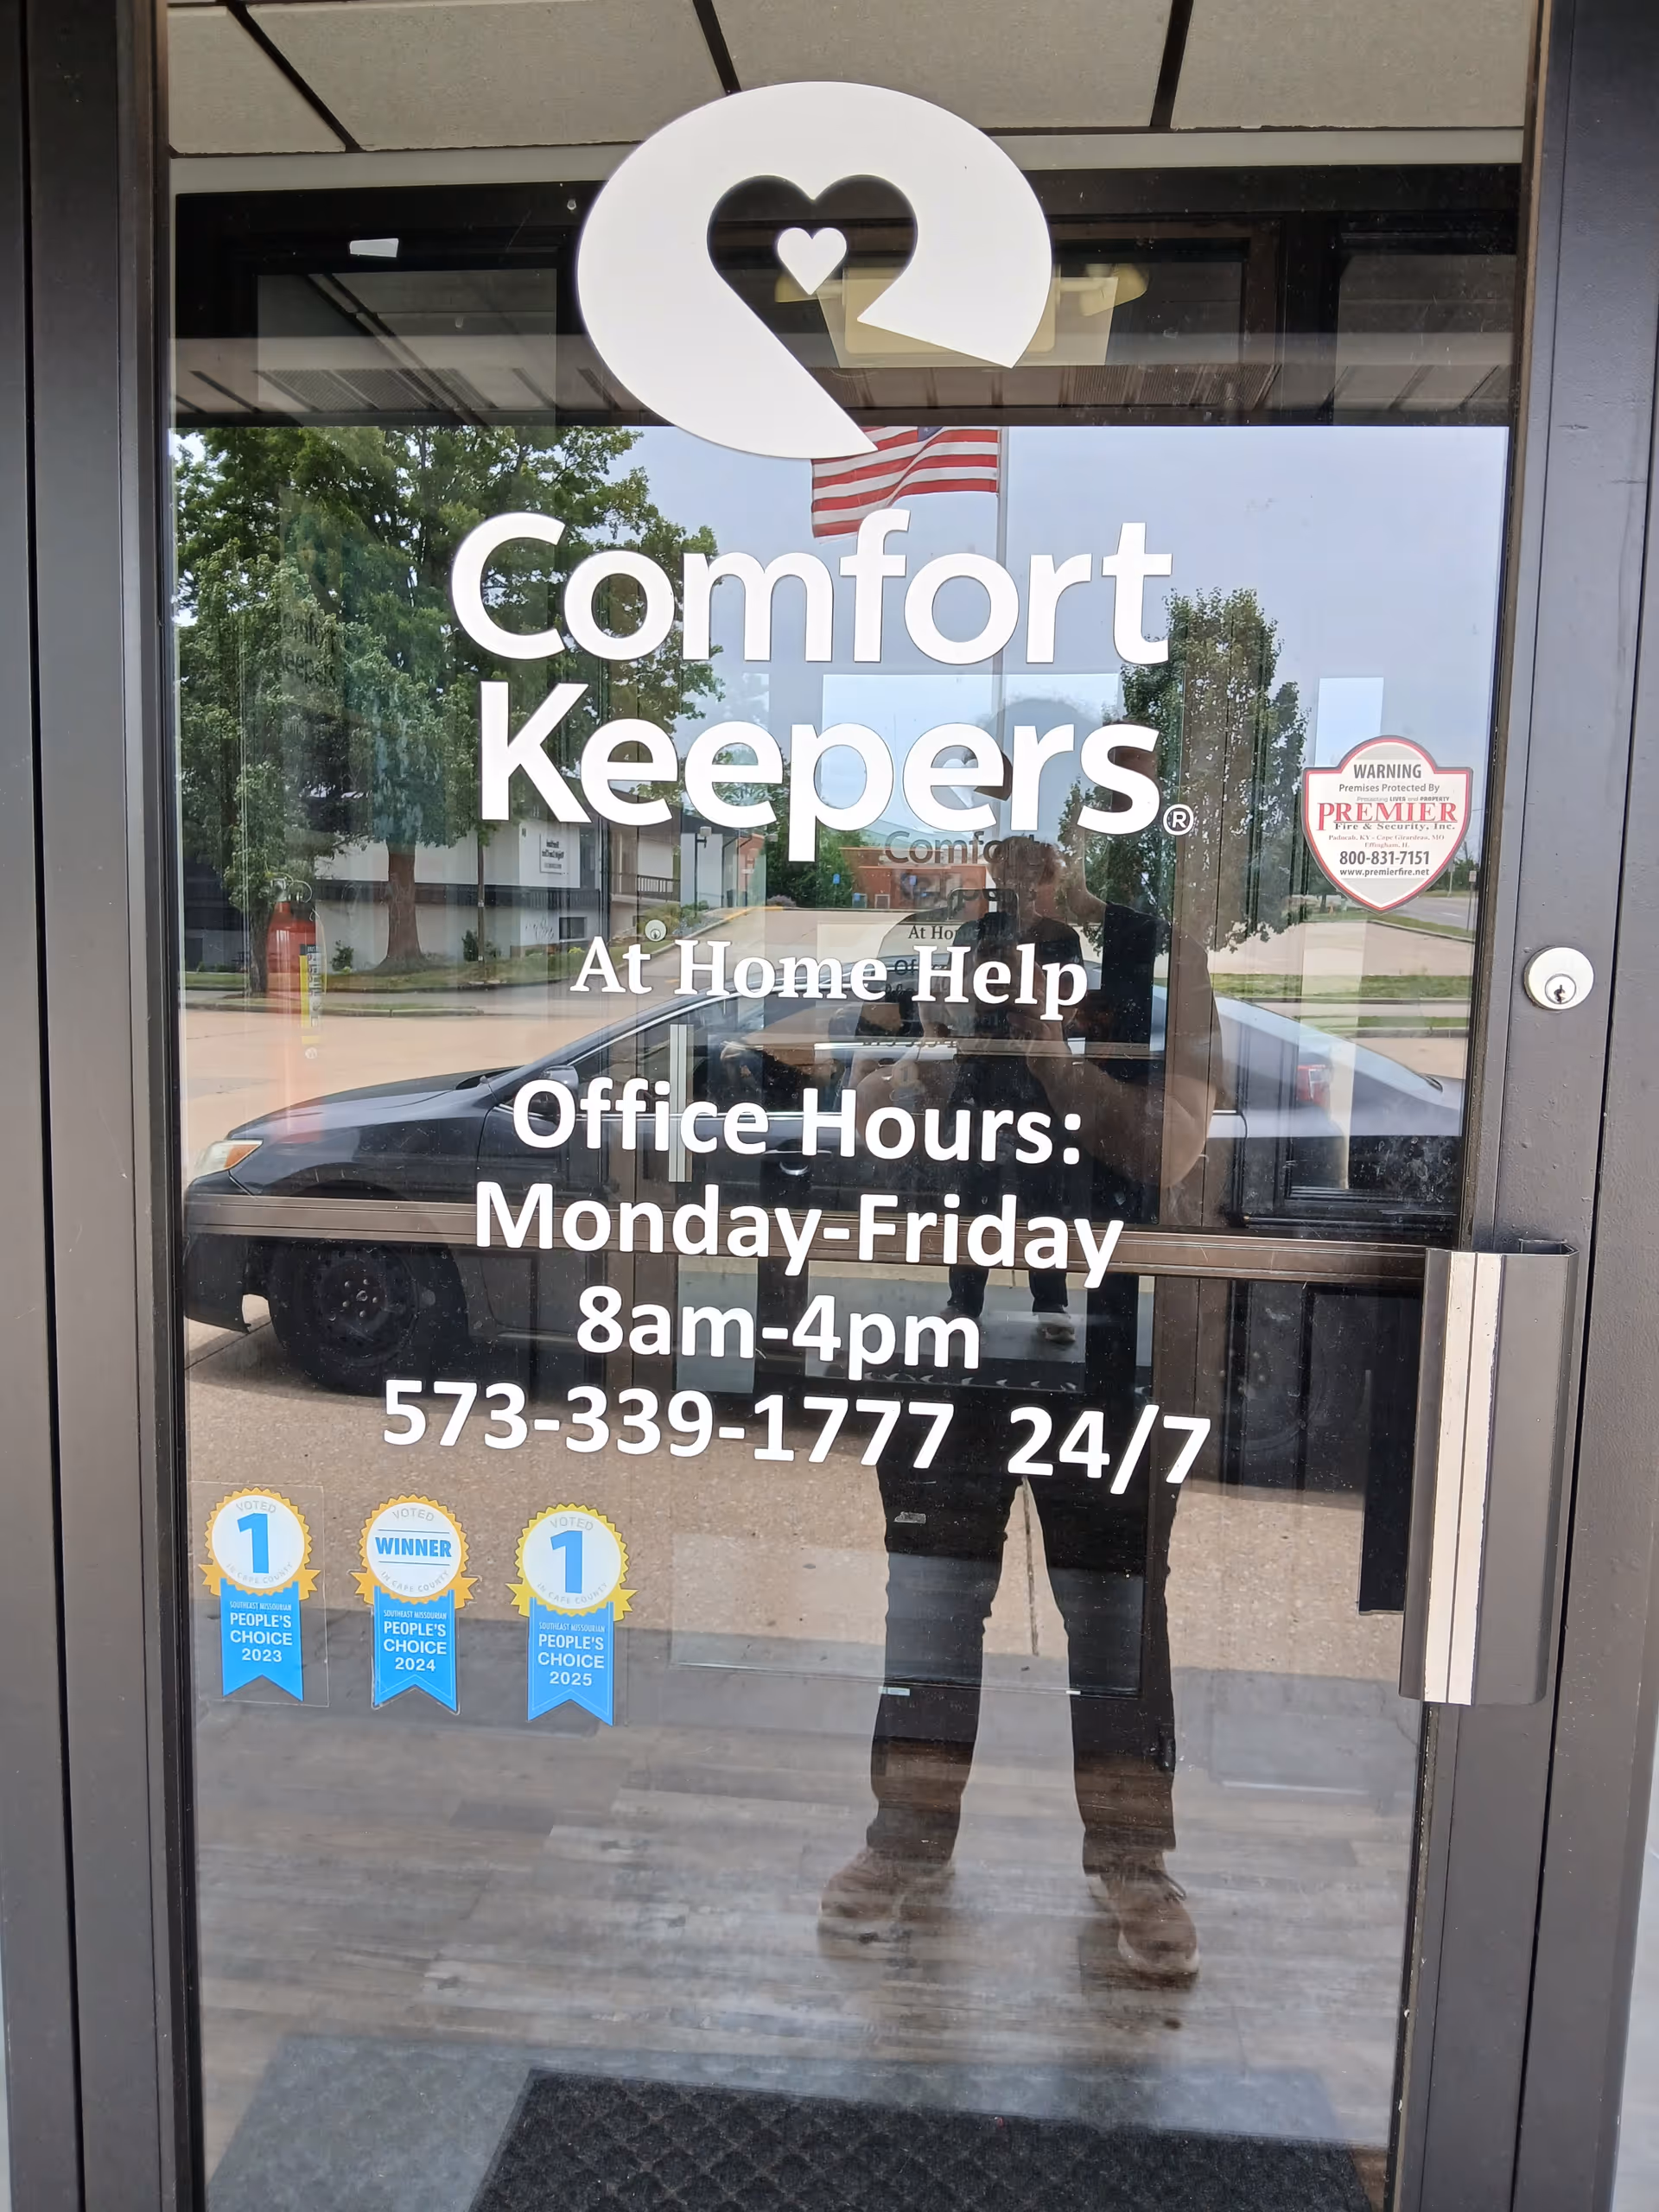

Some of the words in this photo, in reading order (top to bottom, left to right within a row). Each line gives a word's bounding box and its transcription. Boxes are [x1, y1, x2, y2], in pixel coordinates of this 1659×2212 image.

[451, 508, 1173, 665] Comfort
[1353, 764, 1421, 779] WARNING
[1338, 784, 1380, 792] Premises
[1382, 784, 1427, 792] Protected
[1428, 784, 1440, 794] By
[1317, 802, 1458, 831] PREMIER
[1376, 823, 1429, 832] Security,
[1339, 850, 1430, 865] 800-831-7151
[1339, 867, 1430, 878] www.premierfire.net
[907, 925, 926, 939] At
[569, 935, 652, 995] At
[674, 939, 887, 1001] Home
[912, 944, 1088, 1020] Help
[512, 1077, 768, 1156] Office
[802, 1086, 1081, 1165] Hours:
[476, 1180, 1124, 1288] Monday-Friday
[577, 1285, 980, 1382] 8am-4pm
[383, 1379, 954, 1470] 573-339-1777
[1007, 1404, 1211, 1496] 24/7
[235, 1500, 277, 1514] VOTED
[392, 1508, 435, 1522] VOTED
[550, 1516, 594, 1531] VOTED
[237, 1512, 270, 1573] 1
[374, 1536, 452, 1558] WINNER
[550, 1529, 583, 1594] 1
[230, 1611, 292, 1629] PEOPLE'S
[384, 1621, 447, 1637] PEOPLE'S
[230, 1630, 293, 1646] CHOICE
[538, 1633, 604, 1651] PEOPLE'S
[242, 1648, 283, 1662] 2023
[383, 1638, 448, 1656] CHOICE
[395, 1656, 436, 1672] 2024
[537, 1651, 605, 1669] CHOICE
[550, 1670, 593, 1687] 2025
